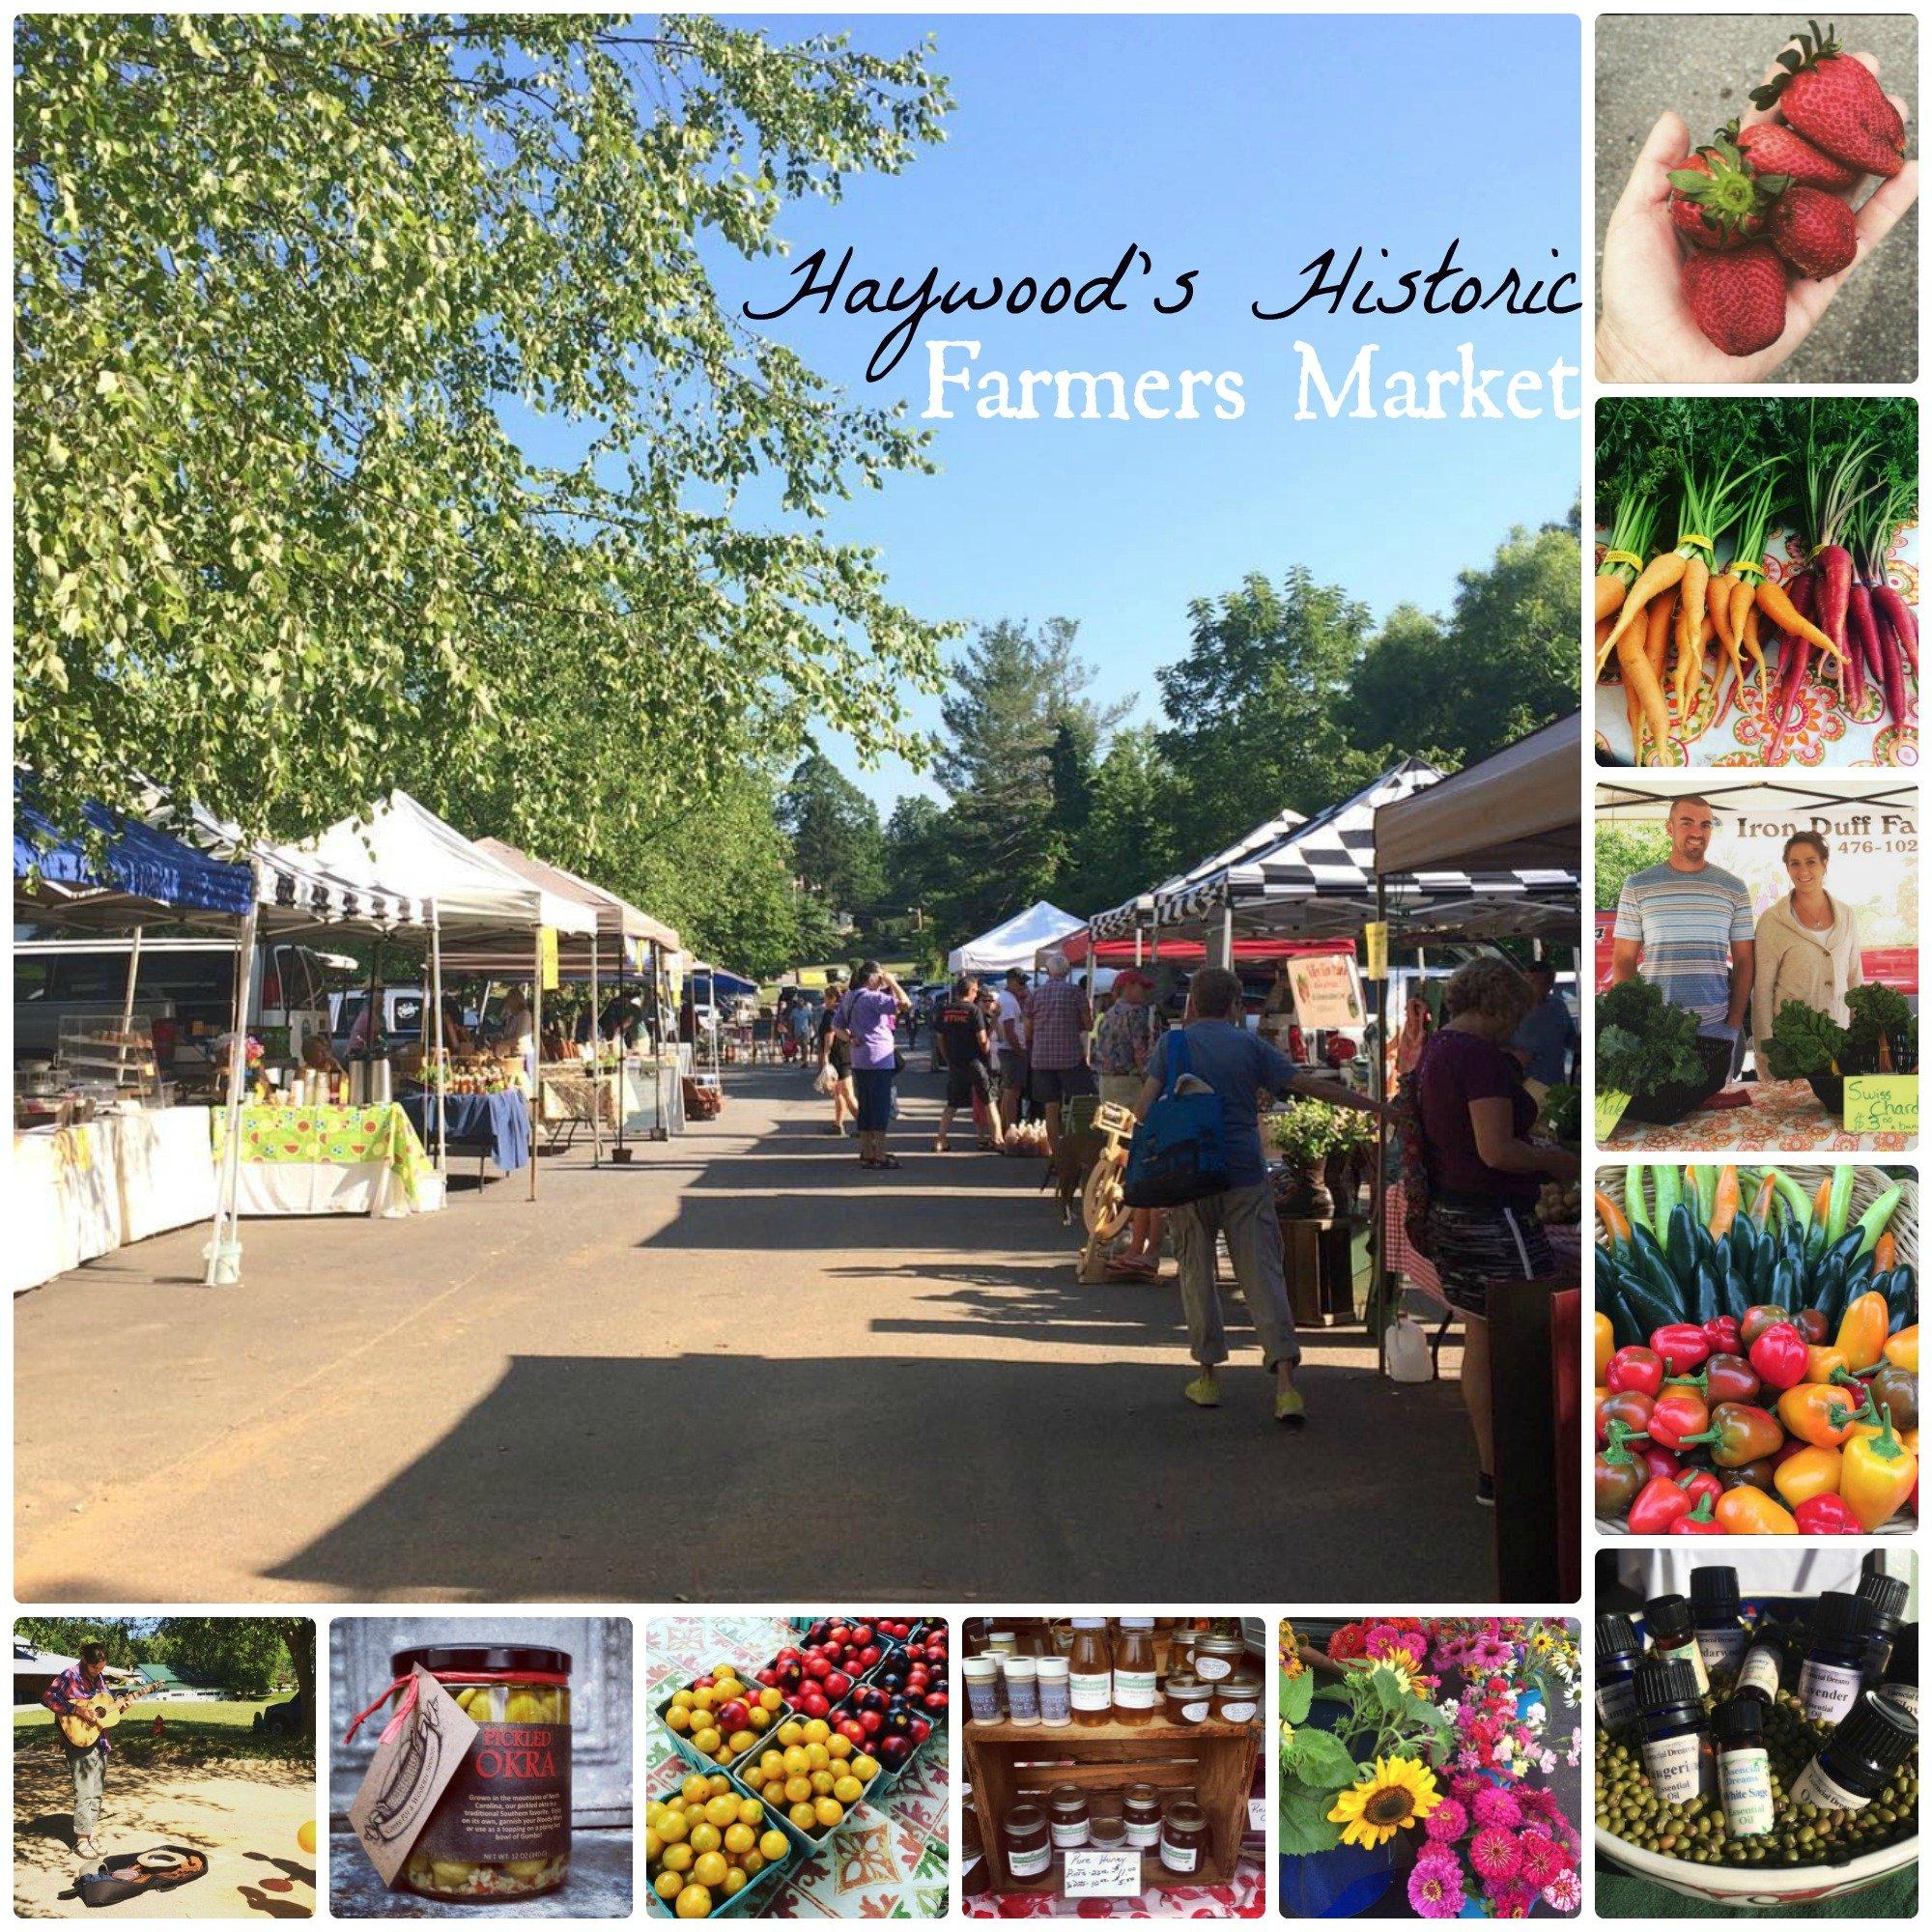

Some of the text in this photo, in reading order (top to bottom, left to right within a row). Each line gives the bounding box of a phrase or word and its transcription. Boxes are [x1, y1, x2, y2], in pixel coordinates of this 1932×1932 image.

[1736, 817, 1797, 838] Iron
[1809, 814, 1872, 837] Duff
[1848, 1080, 1891, 1100] Swiss
[1869, 1094, 1918, 1117] Chard
[1810, 1709, 1823, 1719] Oil
[483, 1728, 553, 1747] PICKLED
[475, 1748, 555, 1779] OKRA
[1666, 1792, 1680, 1801] Oil
[1724, 1788, 1769, 1802] White Sage
[1739, 1816, 1754, 1825] Oil
[1070, 1851, 1127, 1866] Pure Honey
